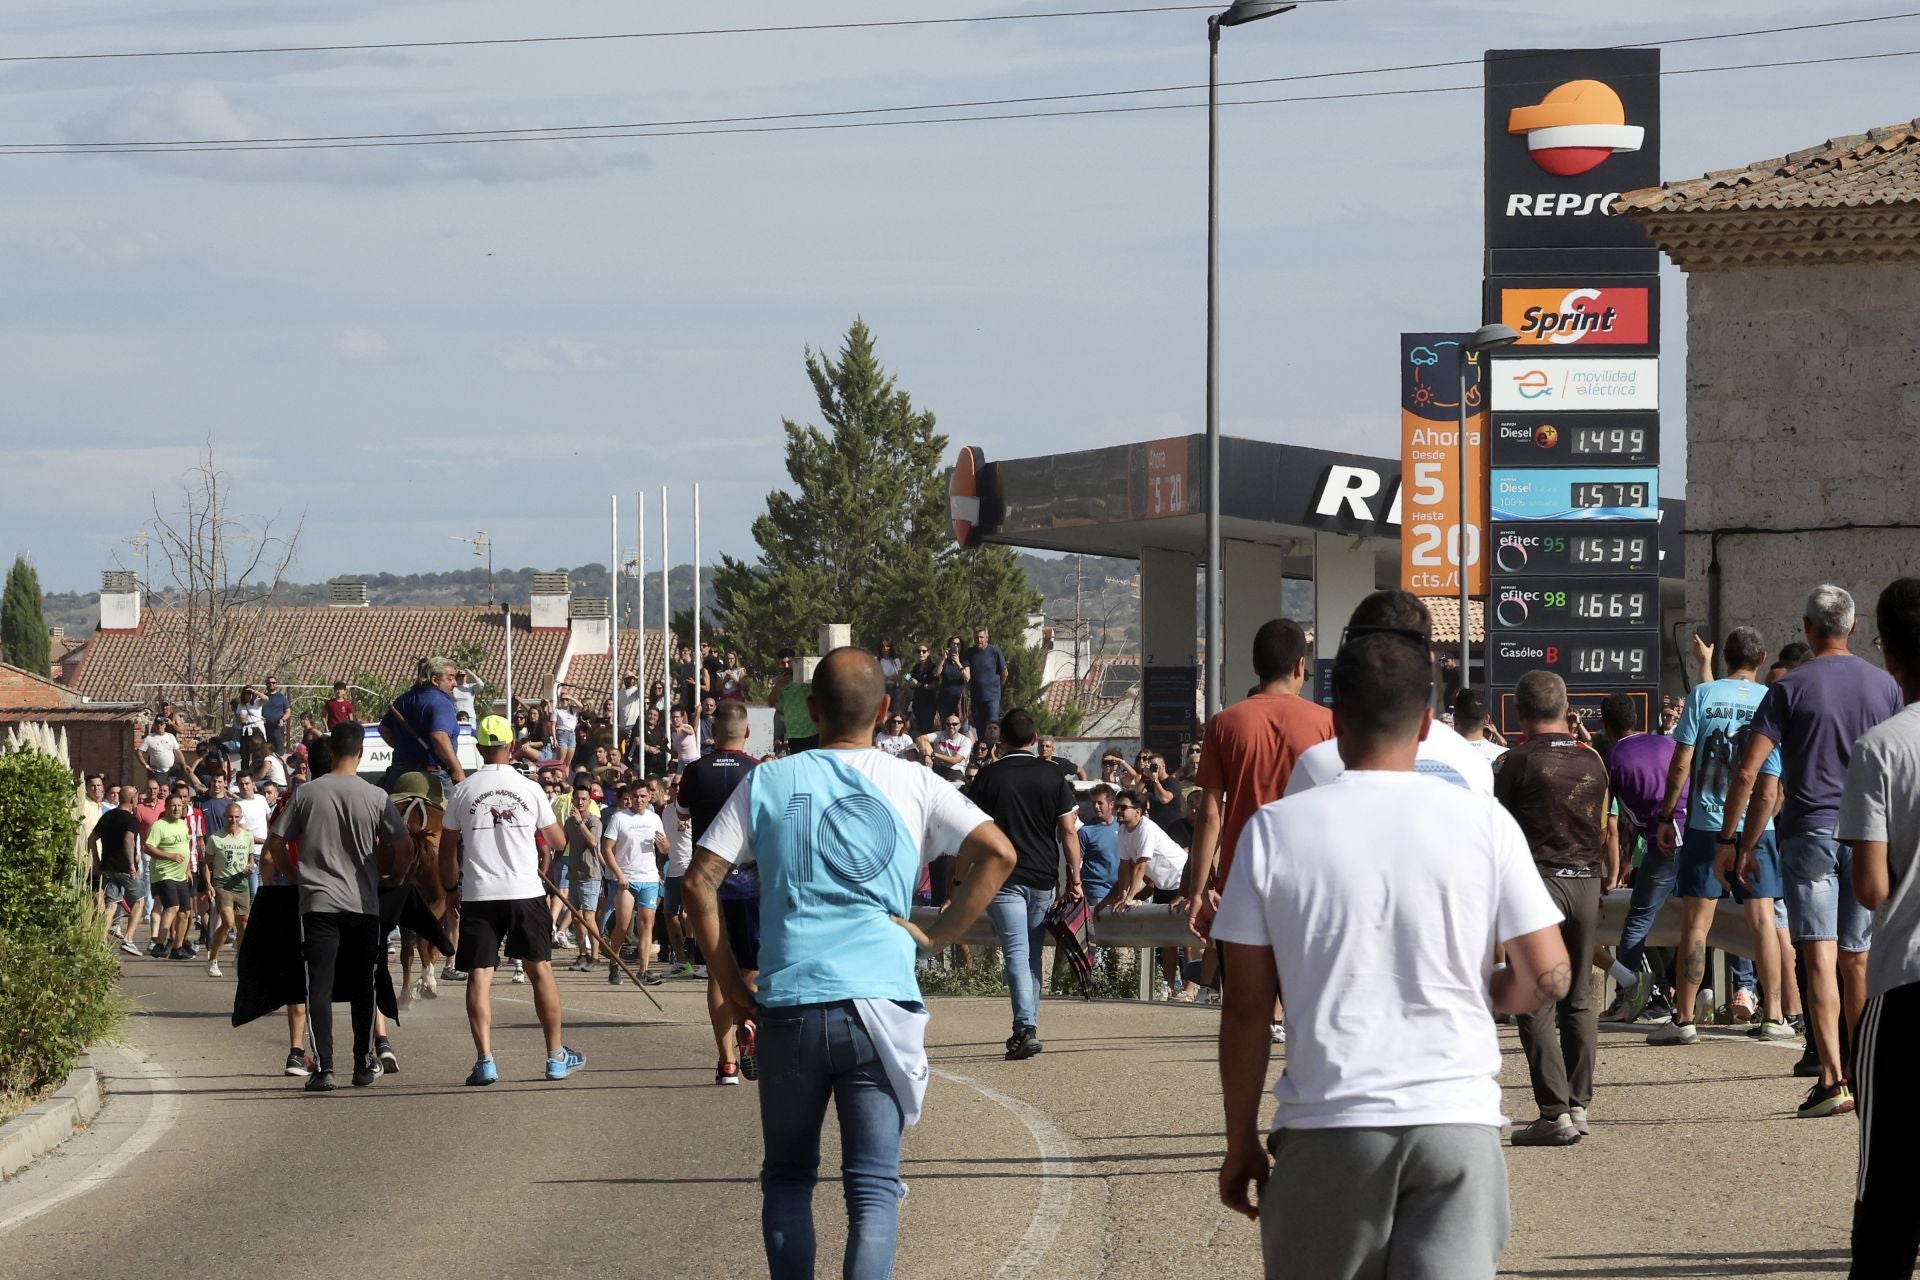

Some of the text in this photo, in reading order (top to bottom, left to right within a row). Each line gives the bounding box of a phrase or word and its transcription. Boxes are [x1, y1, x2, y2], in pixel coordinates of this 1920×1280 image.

[1520, 304, 1617, 341] Sprint
[1573, 370, 1636, 382] movilidad
[1576, 383, 1636, 395] eléctrica
[1500, 427, 1532, 438] Diesel
[1578, 429, 1644, 453] 1.499
[1412, 451, 1446, 460] Desde
[1169, 473, 1182, 511] 20
[1412, 462, 1445, 505] 5
[1500, 482, 1532, 493] Diesel
[1578, 484, 1644, 507] 1.579
[1412, 512, 1444, 521] Hasta
[1411, 523, 1480, 566] 20
[1500, 535, 1565, 554] efitec 95
[1578, 538, 1644, 562] 1.539
[1500, 589, 1566, 608] efitec 98
[1578, 594, 1643, 618] 1.669
[1500, 646, 1559, 664] Gasóleo B
[1578, 648, 1643, 672] 1.049
[1705, 707, 1757, 721] SAN PE
[783, 793, 896, 884] 10
